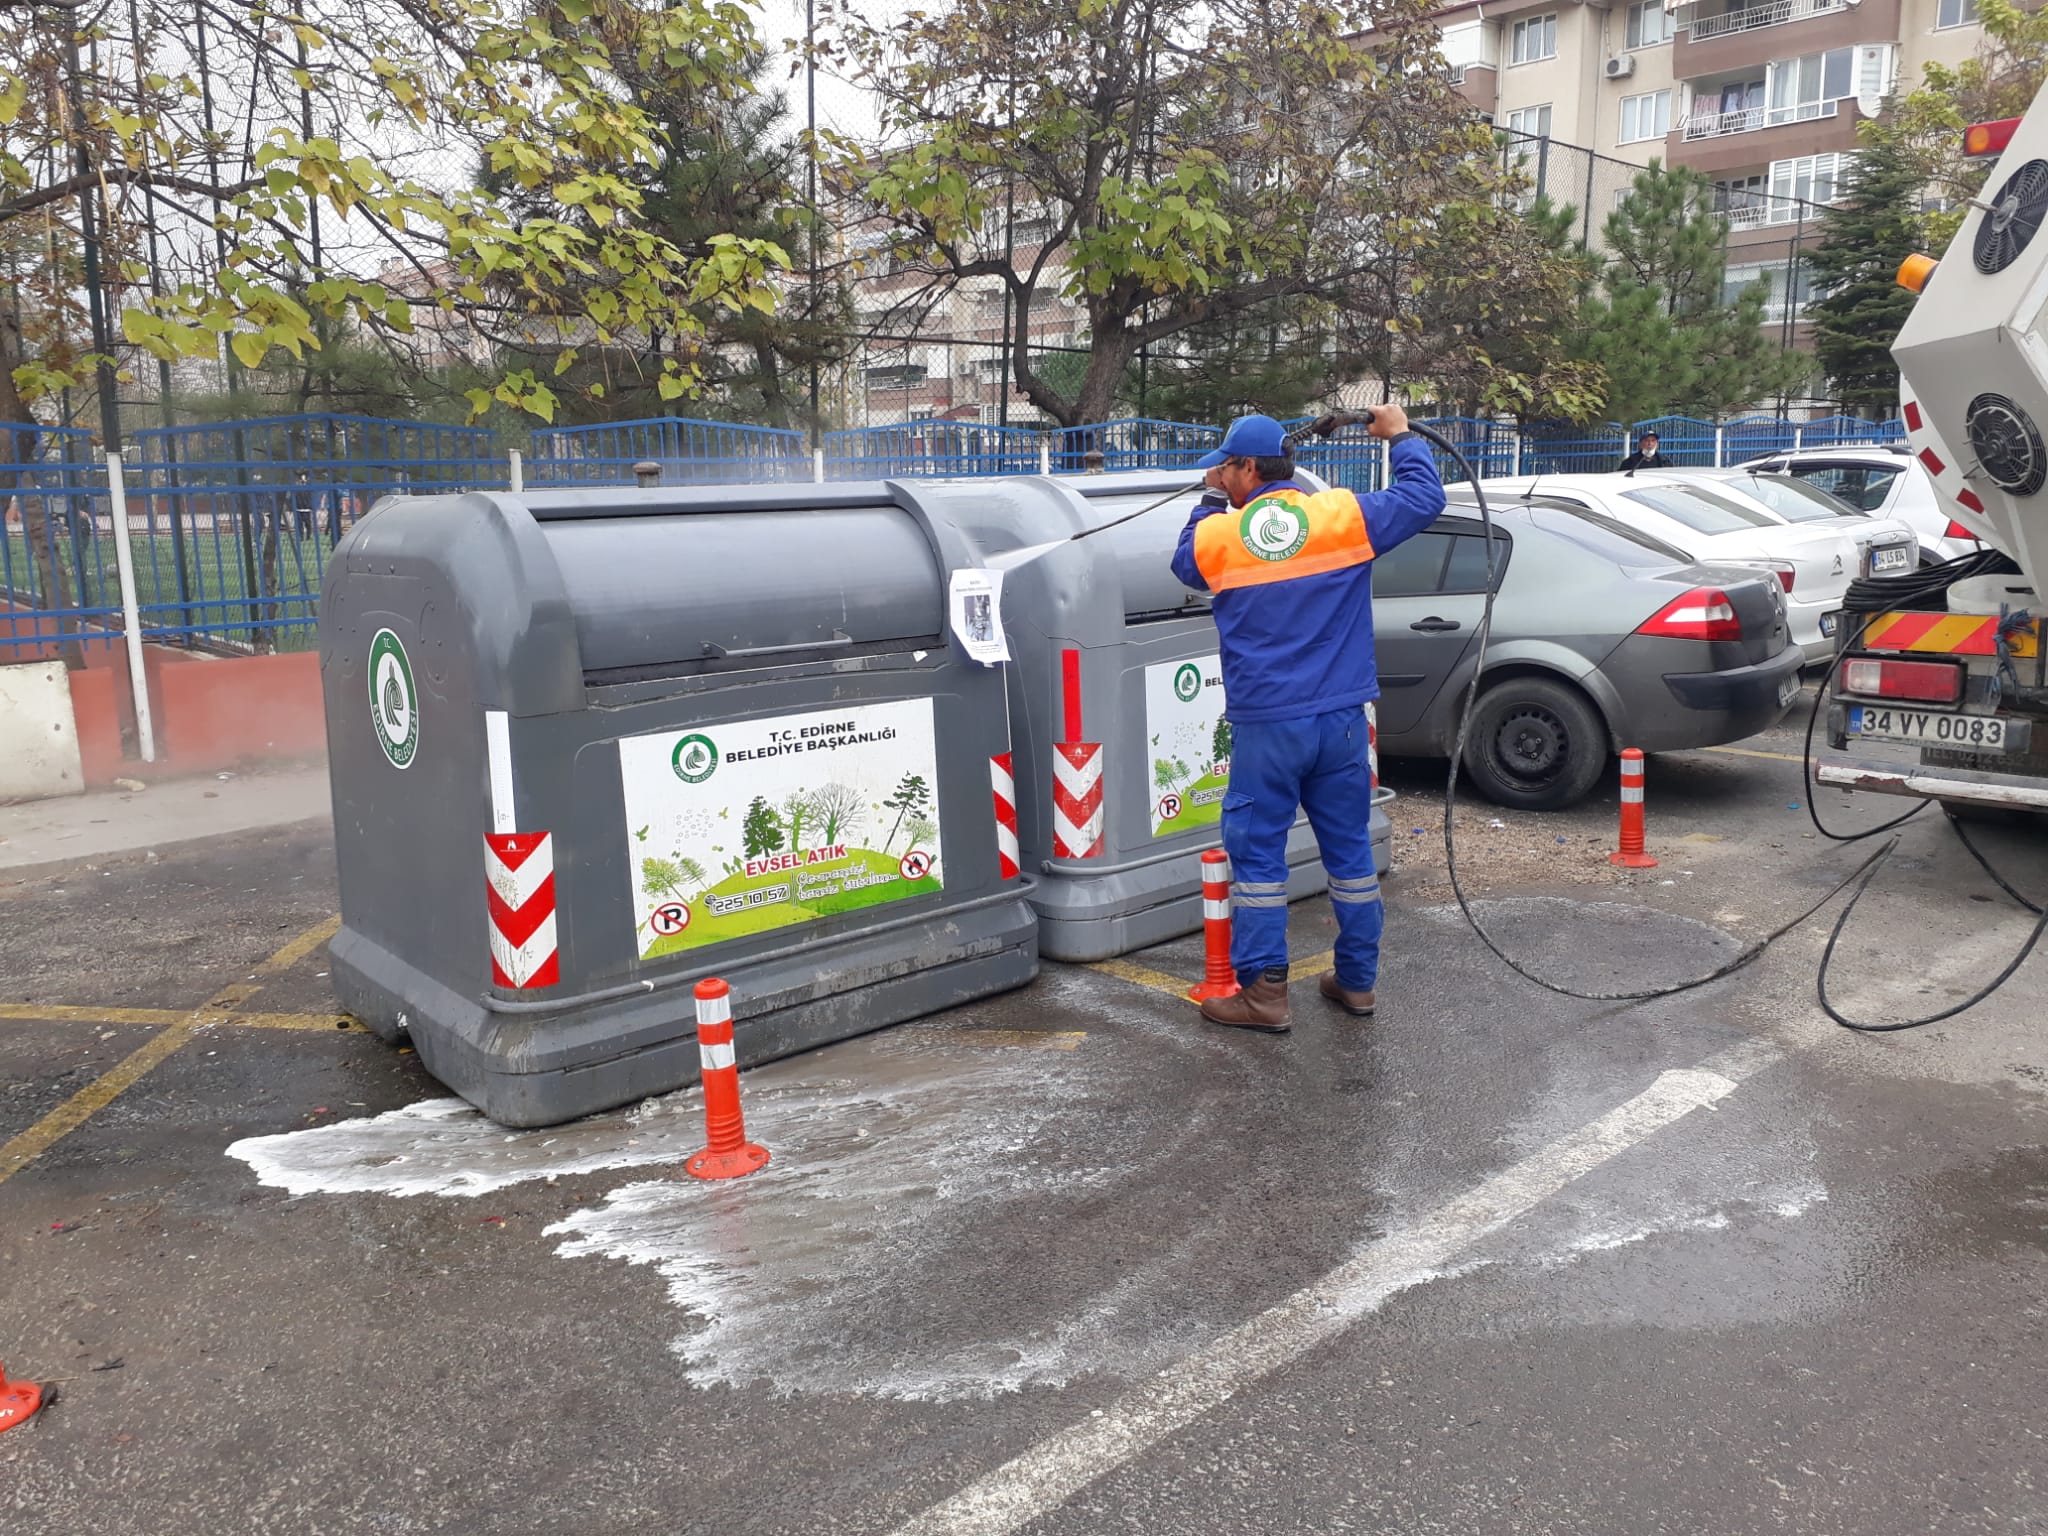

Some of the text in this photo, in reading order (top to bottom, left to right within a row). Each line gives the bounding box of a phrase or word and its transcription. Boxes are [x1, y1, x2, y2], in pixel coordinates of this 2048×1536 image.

[769, 721, 856, 742] T.C. EDİRNE
[1863, 710, 2002, 744] 34 VY 0083
[726, 727, 896, 763] BELEDİYE BAŞKANLIĞI
[746, 844, 847, 877] EVSEL ATIK
[715, 887, 786, 912] 225 10 57
